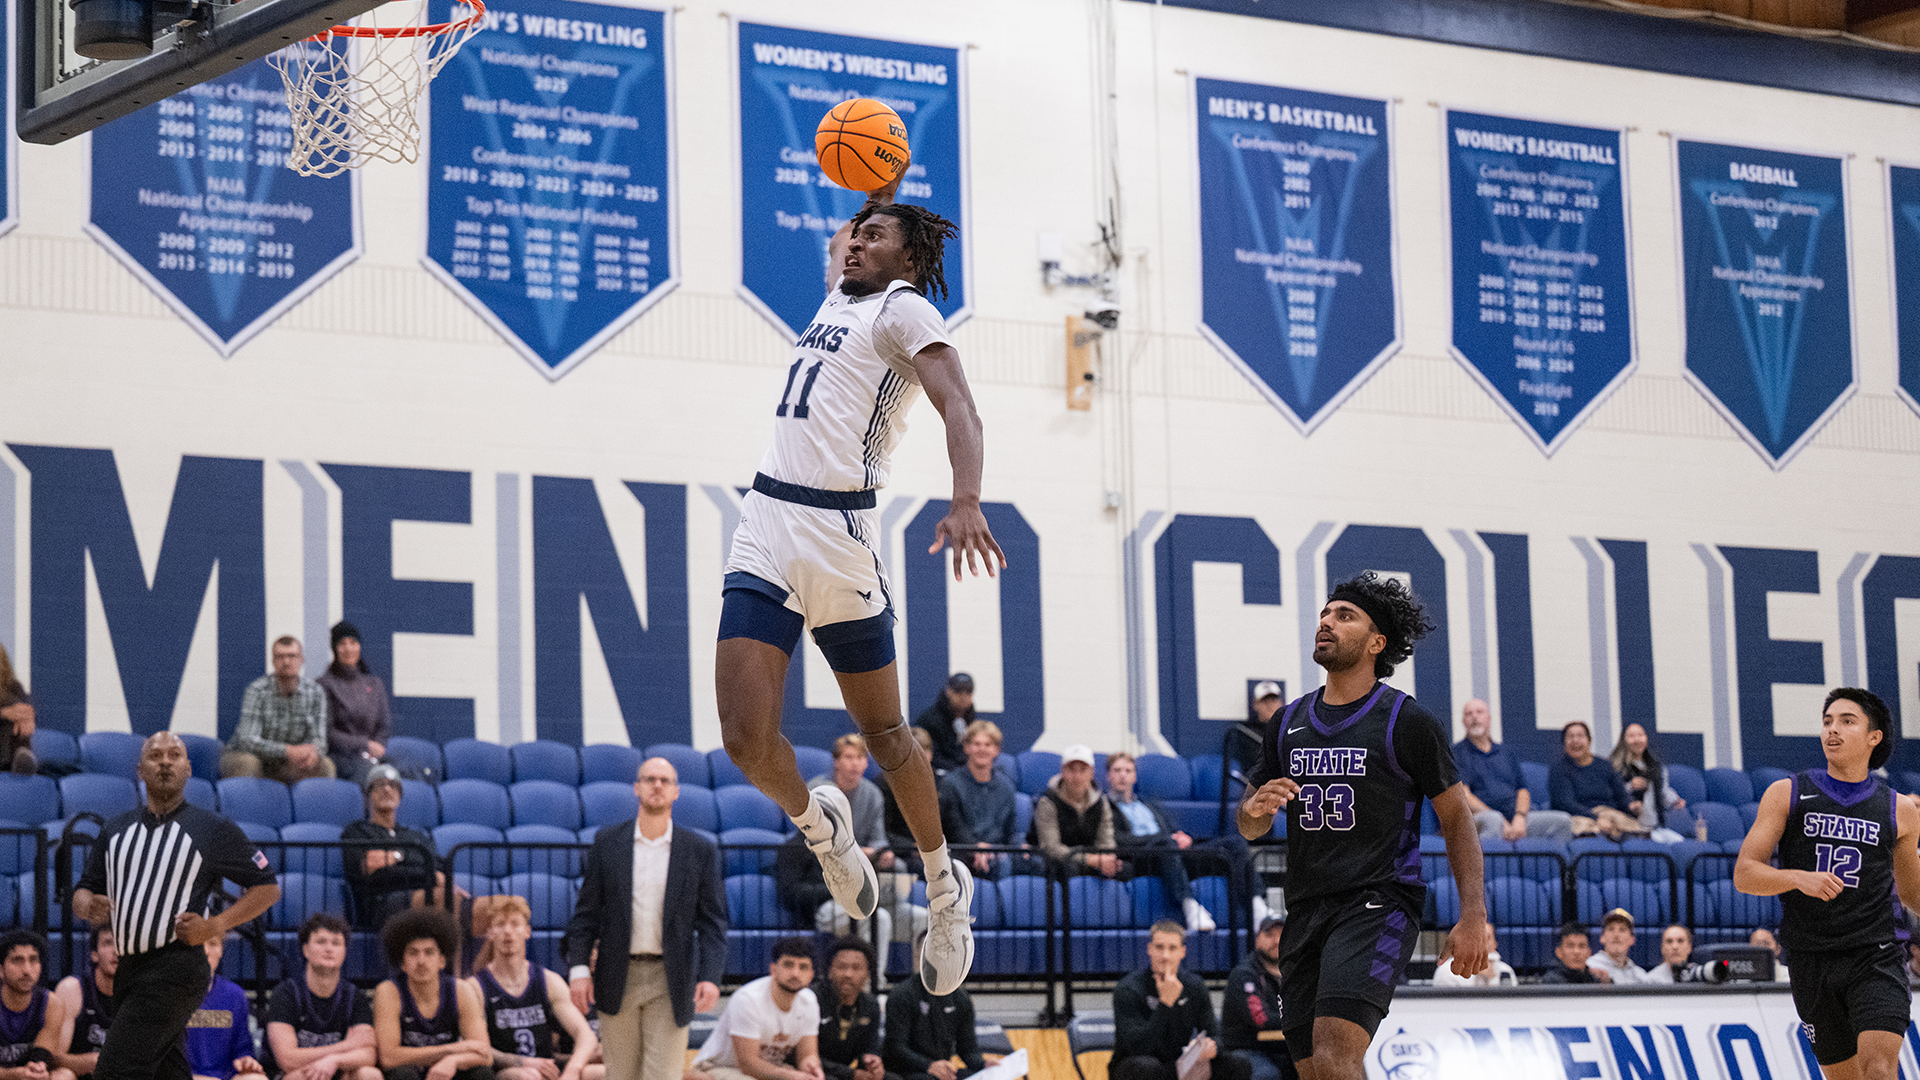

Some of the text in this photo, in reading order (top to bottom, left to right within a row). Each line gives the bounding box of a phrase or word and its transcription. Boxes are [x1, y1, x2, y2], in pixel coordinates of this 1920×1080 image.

[451, 6, 648, 49] MN'S WRESTLING
[481, 48, 619, 79] National Champions
[753, 42, 948, 85] WOMEN'S WRESTLING
[534, 74, 569, 94] 2025
[788, 83, 844, 103] National
[158, 100, 195, 117] 2004
[462, 94, 639, 130] West Regional Champions
[1208, 96, 1378, 136] MEN'S BASKETBALL
[158, 120, 195, 138] 2008
[256, 130, 292, 148] 2012
[1454, 127, 1617, 165] WOMEN'S BASKETBALL
[158, 141, 195, 159] 2013
[207, 146, 244, 162] 2014
[1231, 133, 1358, 163] Conference Champions
[443, 165, 480, 184] 2018
[472, 145, 631, 179] Conference Champions
[1729, 161, 1798, 187] BASEBALL
[206, 176, 246, 195] NAIA
[901, 181, 933, 199] 2025
[1479, 163, 1595, 192] Conference Champions
[138, 188, 314, 224] National Championship
[467, 195, 639, 230] Top Ten National Finishes
[1710, 191, 1820, 217] Conference Champions
[177, 212, 275, 236] Appearances
[775, 210, 800, 231] Top
[801, 213, 826, 230] Ten
[158, 232, 294, 259] 2008 2009 2012
[1480, 239, 1599, 268] National Championship
[158, 253, 296, 279] 2013 2014 2019
[1235, 248, 1363, 278] National Championship
[1508, 258, 1574, 279] Appearances
[1264, 267, 1337, 289] Appearances
[1712, 265, 1825, 291] National Championship
[1577, 284, 1604, 301] 2012
[1739, 283, 1801, 301] Appearances
[1512, 335, 1548, 353] Round
[1561, 339, 1576, 355] 16
[776, 357, 824, 419] 11
[1518, 379, 1574, 401] Final Eight
[1290, 747, 1367, 776] STATE
[1299, 783, 1356, 831] 33
[1803, 812, 1880, 846] STATE
[1815, 843, 1862, 888] 12
[514, 1028, 536, 1057] 3
[1392, 1043, 1422, 1058] OAKS
